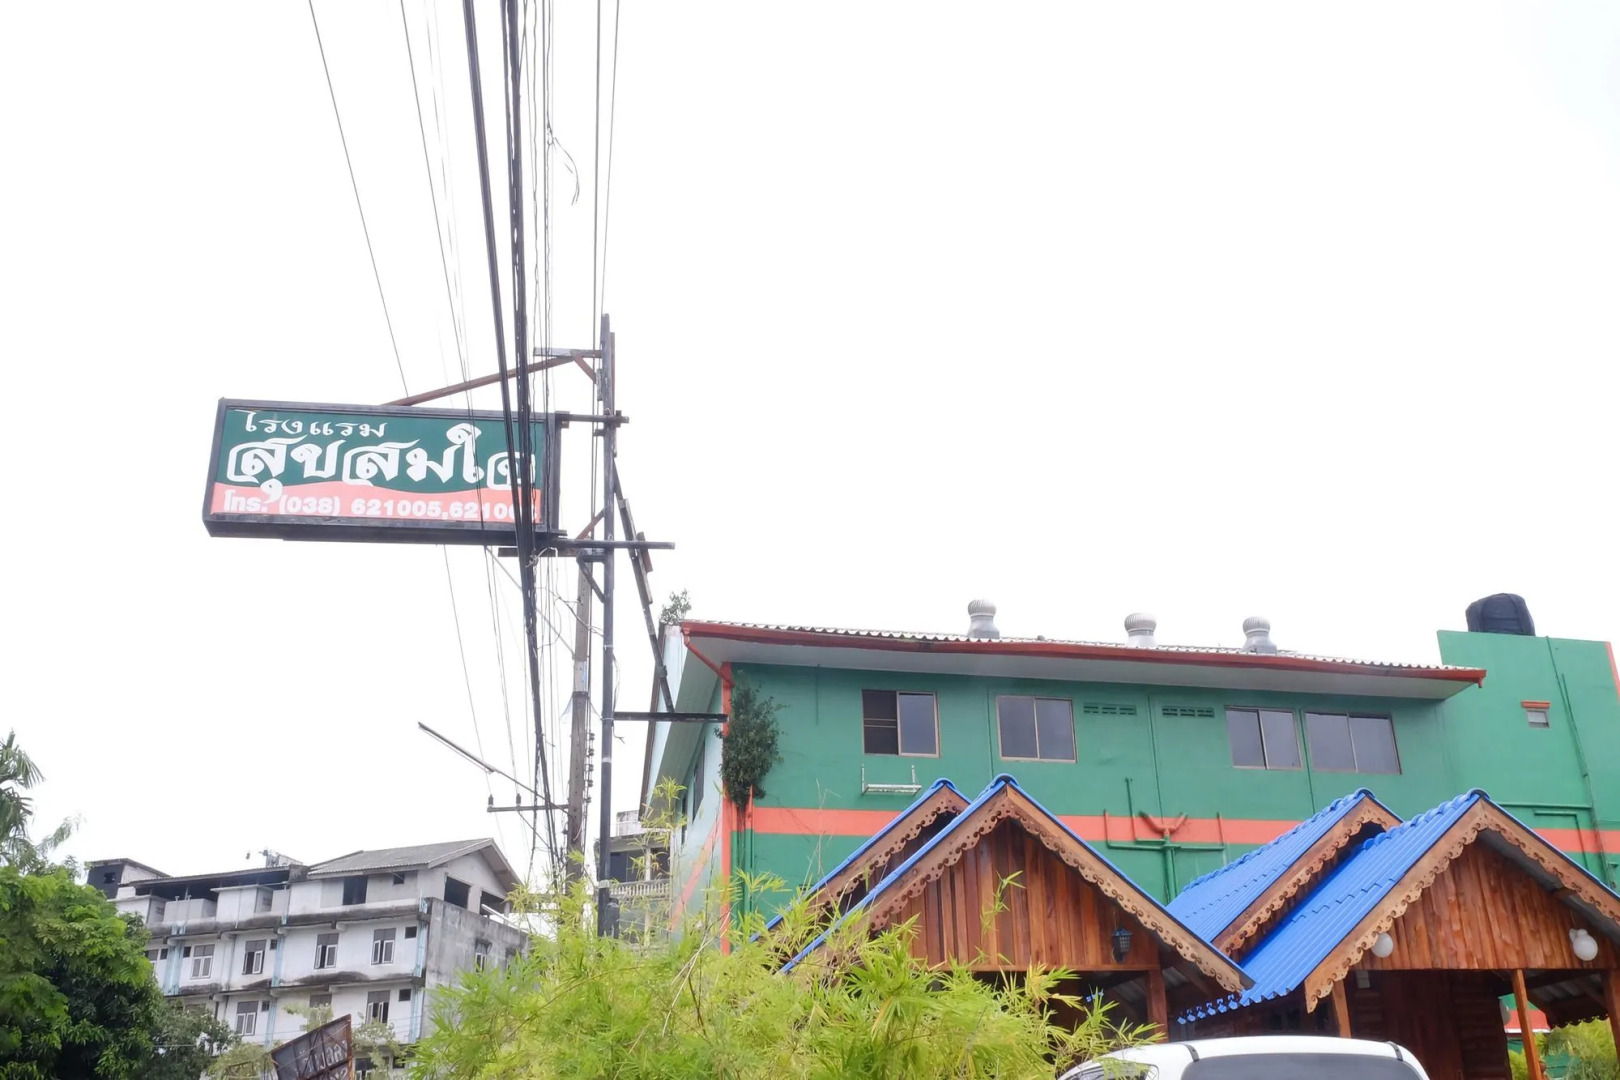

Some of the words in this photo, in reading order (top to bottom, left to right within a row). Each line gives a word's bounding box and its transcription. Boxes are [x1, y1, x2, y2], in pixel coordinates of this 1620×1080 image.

[235, 409, 388, 438] โรงแรม
[223, 489, 268, 513] โทร.
[278, 494, 341, 516] (038)
